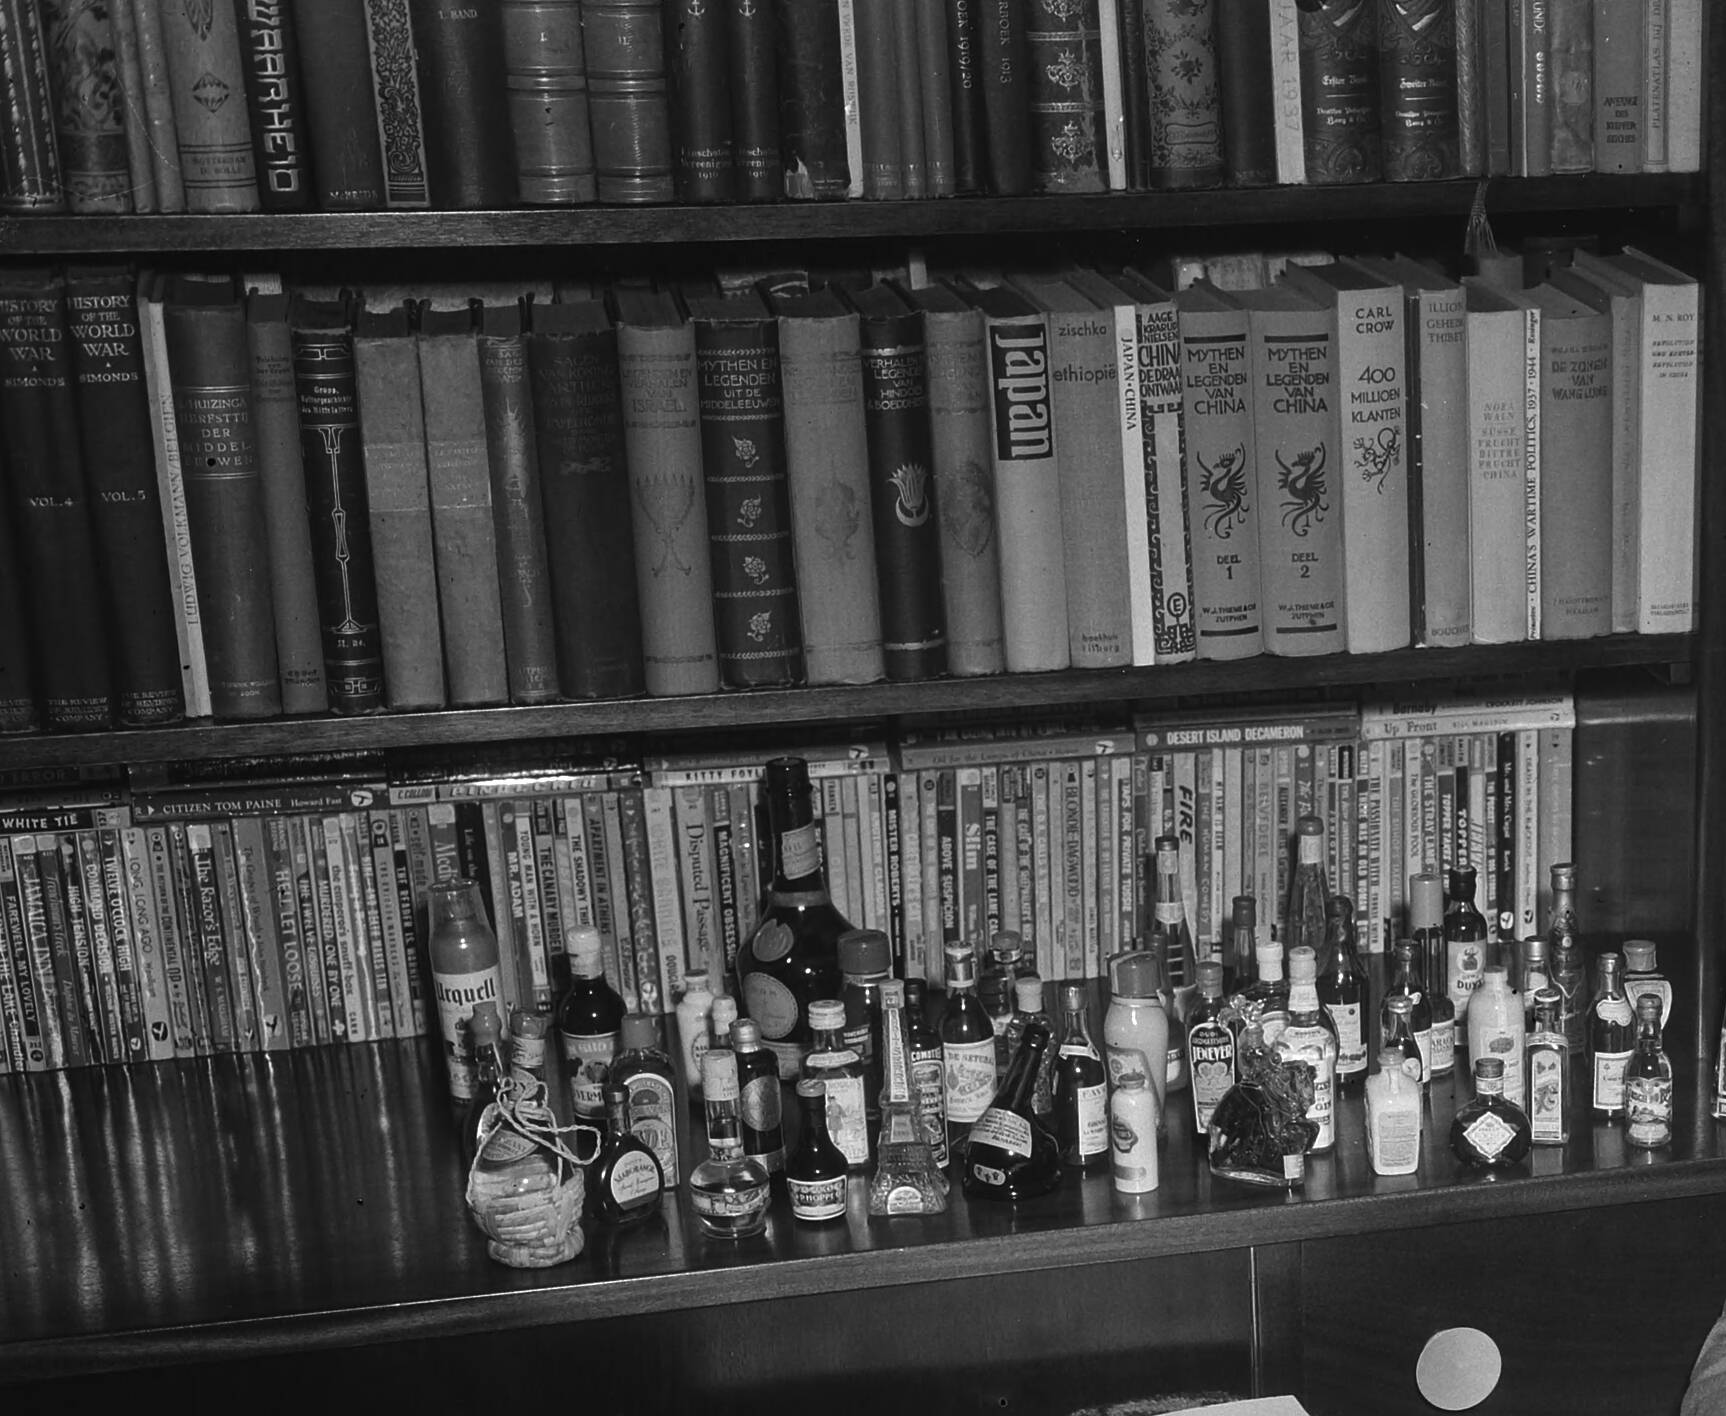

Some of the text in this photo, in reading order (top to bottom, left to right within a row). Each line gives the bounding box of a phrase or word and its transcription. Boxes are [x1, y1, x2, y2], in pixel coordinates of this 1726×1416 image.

[1146, 314, 1174, 324] AAGE
[1355, 306, 1393, 319] CARL
[0, 328, 62, 343] WORLD
[70, 324, 135, 339] WORLD
[1058, 322, 1107, 337] zischka
[1356, 321, 1395, 335] CROW
[1143, 333, 1179, 343] NIELSEN
[8, 345, 53, 361] WAR
[83, 342, 129, 357] WAR
[1188, 347, 1245, 361] MYTHEN
[1267, 347, 1328, 361] MYTHEN
[1053, 362, 1116, 384] ethiopië
[1209, 363, 1229, 374] EN
[1288, 362, 1310, 373] EN
[1358, 365, 1397, 385] 400
[79, 371, 139, 383] SIMONDS
[704, 375, 776, 387] LEGENDEN
[1120, 338, 1138, 431] JAPAN CHINA
[1187, 373, 1248, 387] LEGENDEN
[1265, 373, 1330, 386] LEGENDEN
[1570, 376, 1594, 387] VAN
[724, 388, 761, 398] UIT DE
[1205, 388, 1235, 399] VAN
[1284, 387, 1315, 398] VAN
[1351, 388, 1401, 403] MILLIOEN
[1194, 400, 1247, 415] CHINA
[1273, 400, 1329, 414] CHINA
[1351, 407, 1401, 423] KLANTEN
[201, 428, 232, 439] DER
[1526, 357, 1538, 594] CHINA'S WARTIME POLITICS, 1937 1944
[1217, 553, 1242, 565] DEEL
[1291, 552, 1318, 563] DEEL
[1226, 566, 1234, 579] 1
[1299, 566, 1311, 579] 2
[180, 563, 199, 625] LUDWIG
[1167, 726, 1304, 745] DESERT ISLAND DECAMERON
[1383, 720, 1438, 735] Up Front
[686, 771, 725, 781] KITTY
[1503, 762, 1512, 776] Mr.
[162, 799, 282, 815] CITIZEN TOM PAINE
[1179, 785, 1193, 844] FIRE
[2, 813, 79, 830] WHITE TIE
[1257, 783, 1269, 858] BELVEDERE
[1424, 775, 1435, 865] THE STRAY LAMB
[1441, 794, 1452, 860] TOPPER TAKES
[1122, 785, 1131, 875] TAPS FOR PRIVATE
[1458, 809, 1467, 865] TOPPER
[965, 823, 981, 870] Slim
[1202, 829, 1210, 871] HUMAN
[1357, 792, 1368, 911] THERE WAS AN OLD WOMAN
[888, 810, 901, 906] MISTER ROBERTS
[986, 816, 998, 915] THE CASE OF THE LAME
[521, 831, 537, 911] YOUNG WITH
[571, 835, 587, 902] THE SHADOWY
[717, 831, 732, 904] MAGNIFICENT
[508, 852, 524, 918] MR. ADAM
[589, 819, 611, 935] APARTMENT IN ATHENS
[942, 836, 954, 928] ABOVE SUSPICION
[86, 863, 101, 919] COMMAND
[685, 823, 712, 952] Disputed Passage
[540, 847, 561, 953] THE CANARY MURDER
[1201, 879, 1209, 924] COMEDY
[104, 856, 132, 972] TWELVE HIGH
[197, 858, 222, 966] The Razor's Edge
[67, 885, 88, 967] HIGH TENSION
[133, 895, 152, 954] LONG AGO
[280, 912, 303, 990] LET LOOSE
[324, 945, 342, 1008] ONE BY ONE
[17, 961, 35, 1022] MY LOVELY
[1191, 1045, 1233, 1062] JENEVER
